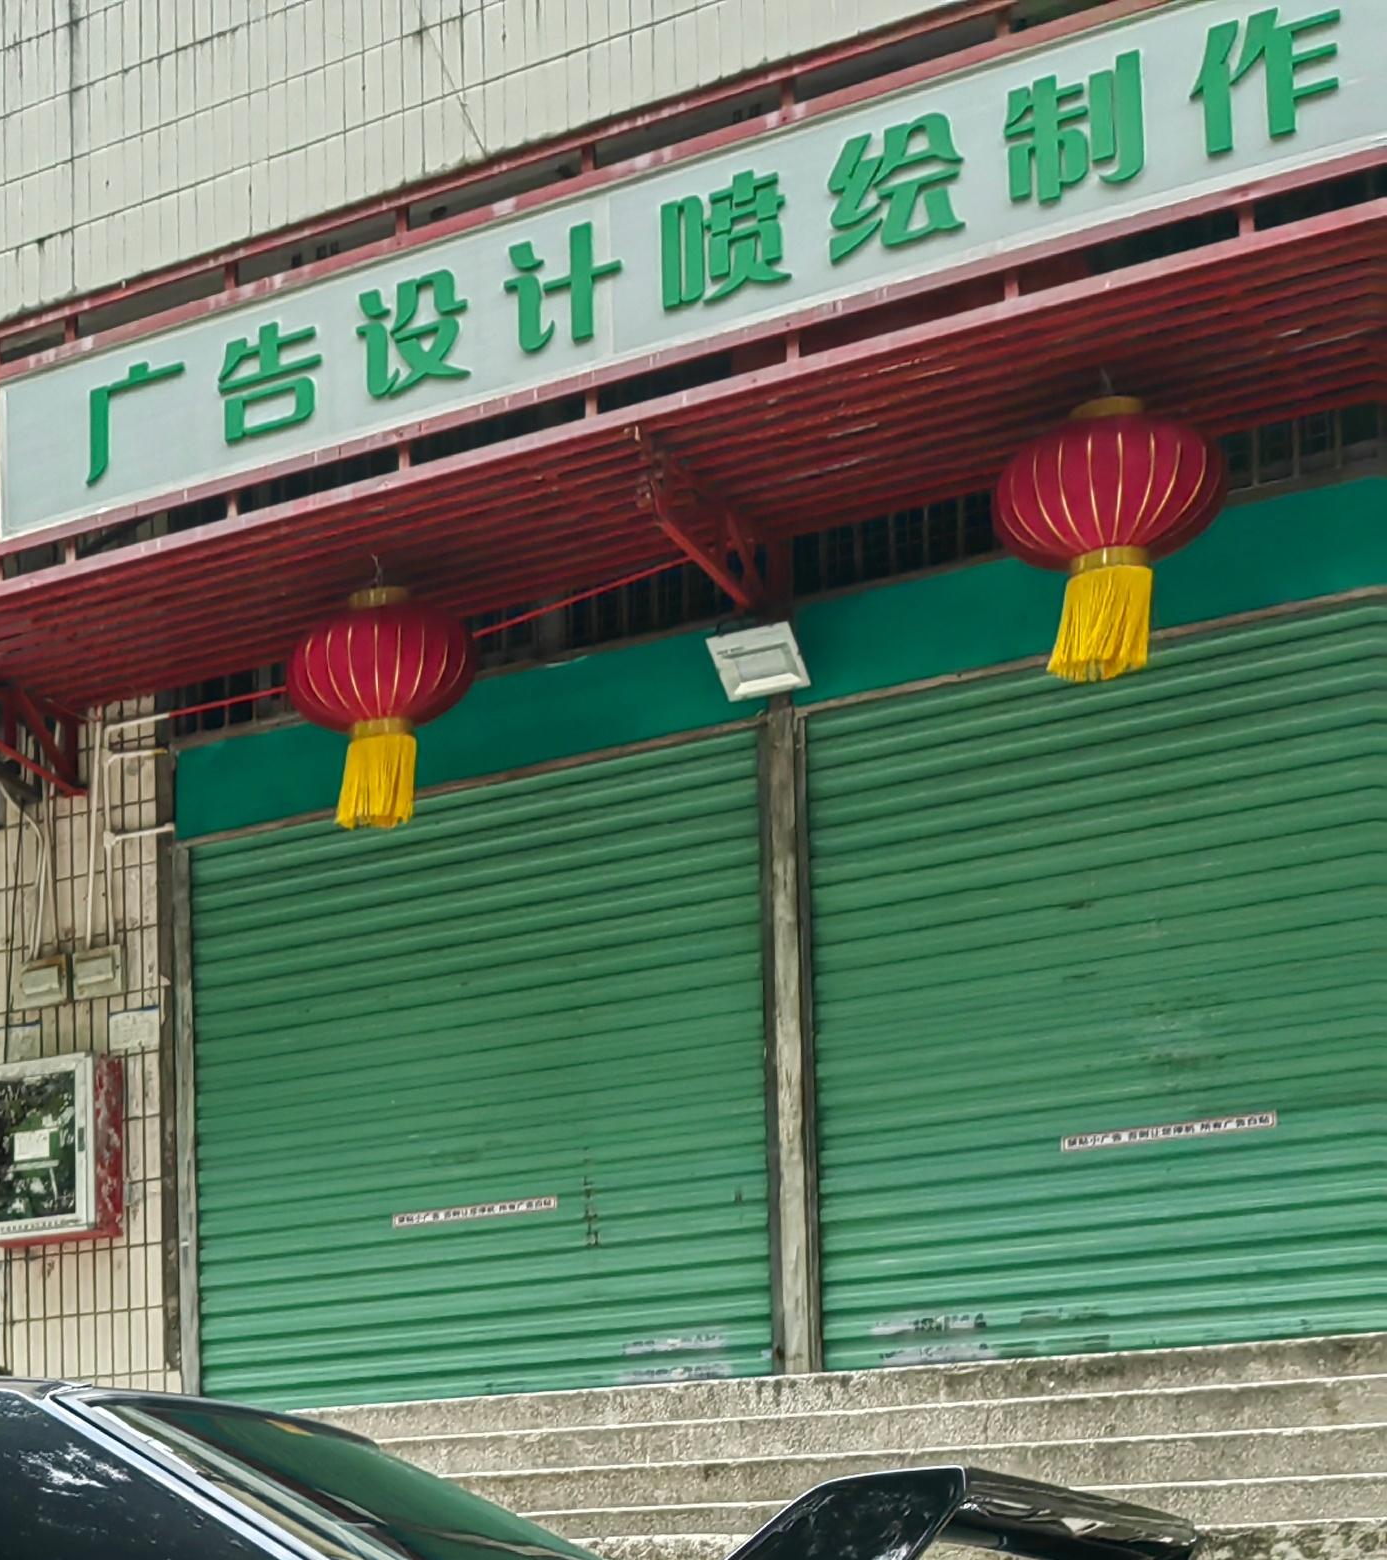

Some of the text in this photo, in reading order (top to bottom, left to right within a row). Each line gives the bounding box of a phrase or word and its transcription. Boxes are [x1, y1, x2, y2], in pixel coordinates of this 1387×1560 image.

[86, 6, 1342, 488] 广告设计喷绘制作
